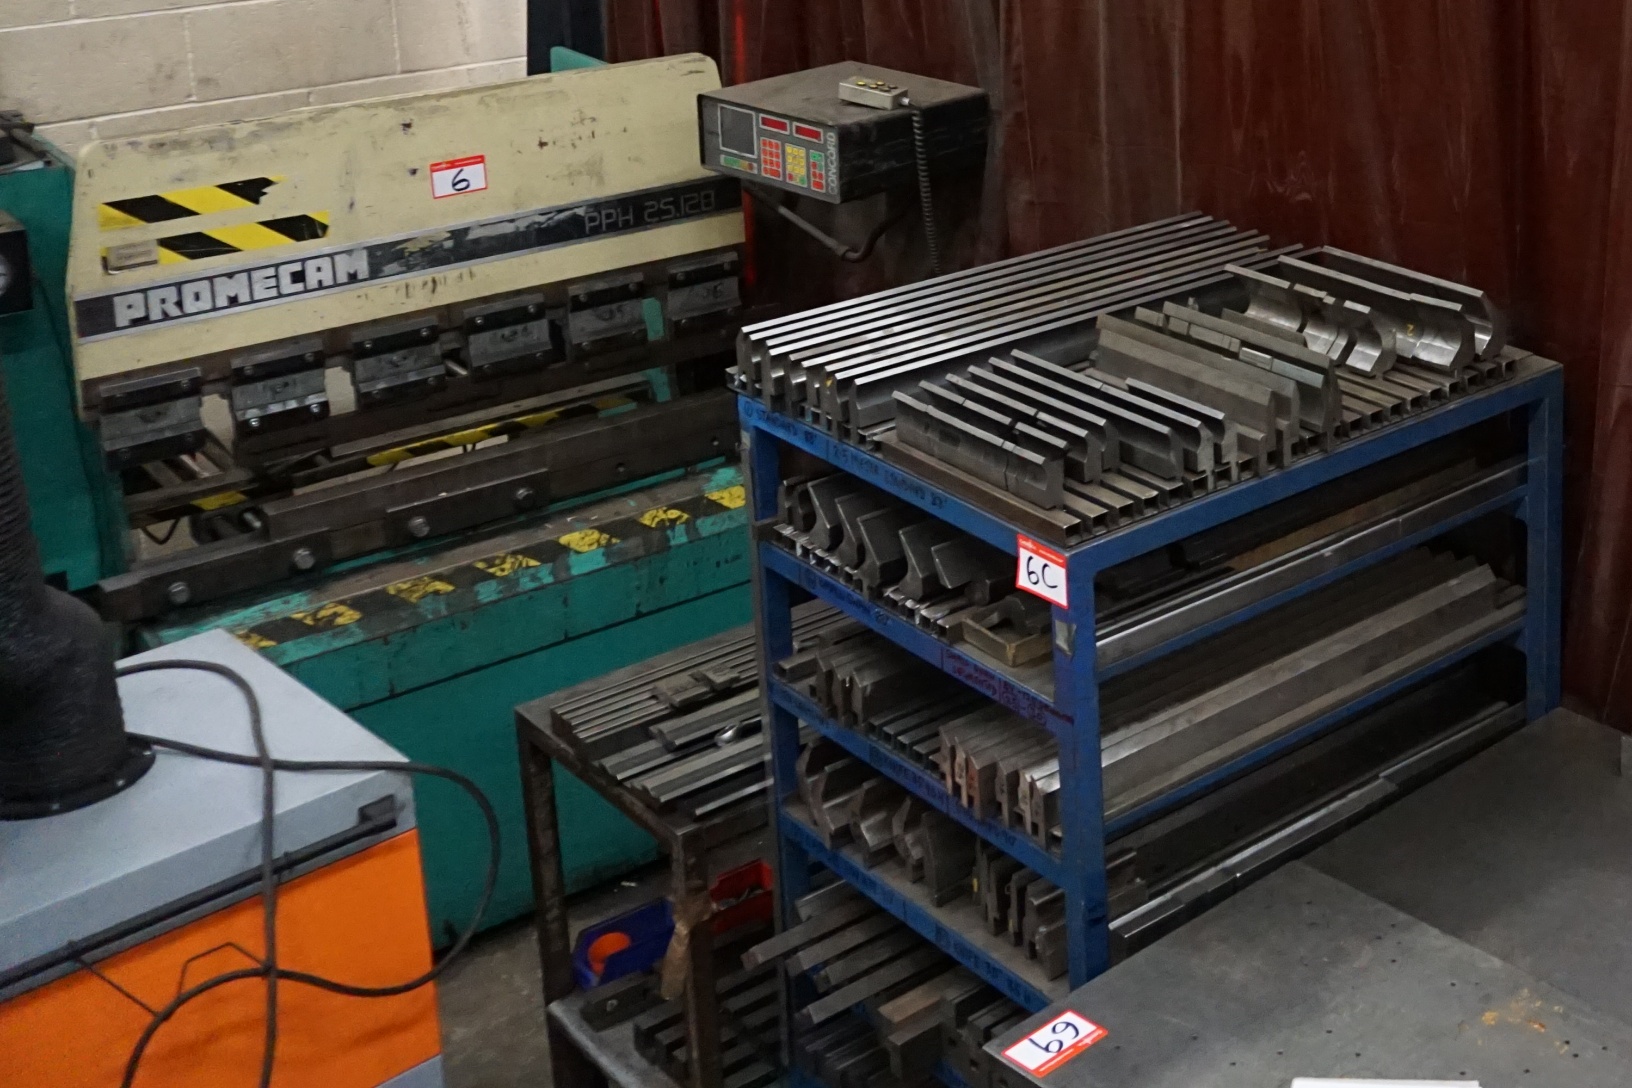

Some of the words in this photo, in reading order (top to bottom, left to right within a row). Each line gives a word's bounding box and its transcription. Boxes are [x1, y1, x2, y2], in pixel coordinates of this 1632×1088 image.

[451, 168, 470, 192] 6
[826, 131, 838, 195] CONCORD
[584, 205, 634, 234] PPH
[643, 189, 715, 223] 25.128
[113, 248, 370, 328] PROMECAM
[1026, 555, 1059, 589] 6C
